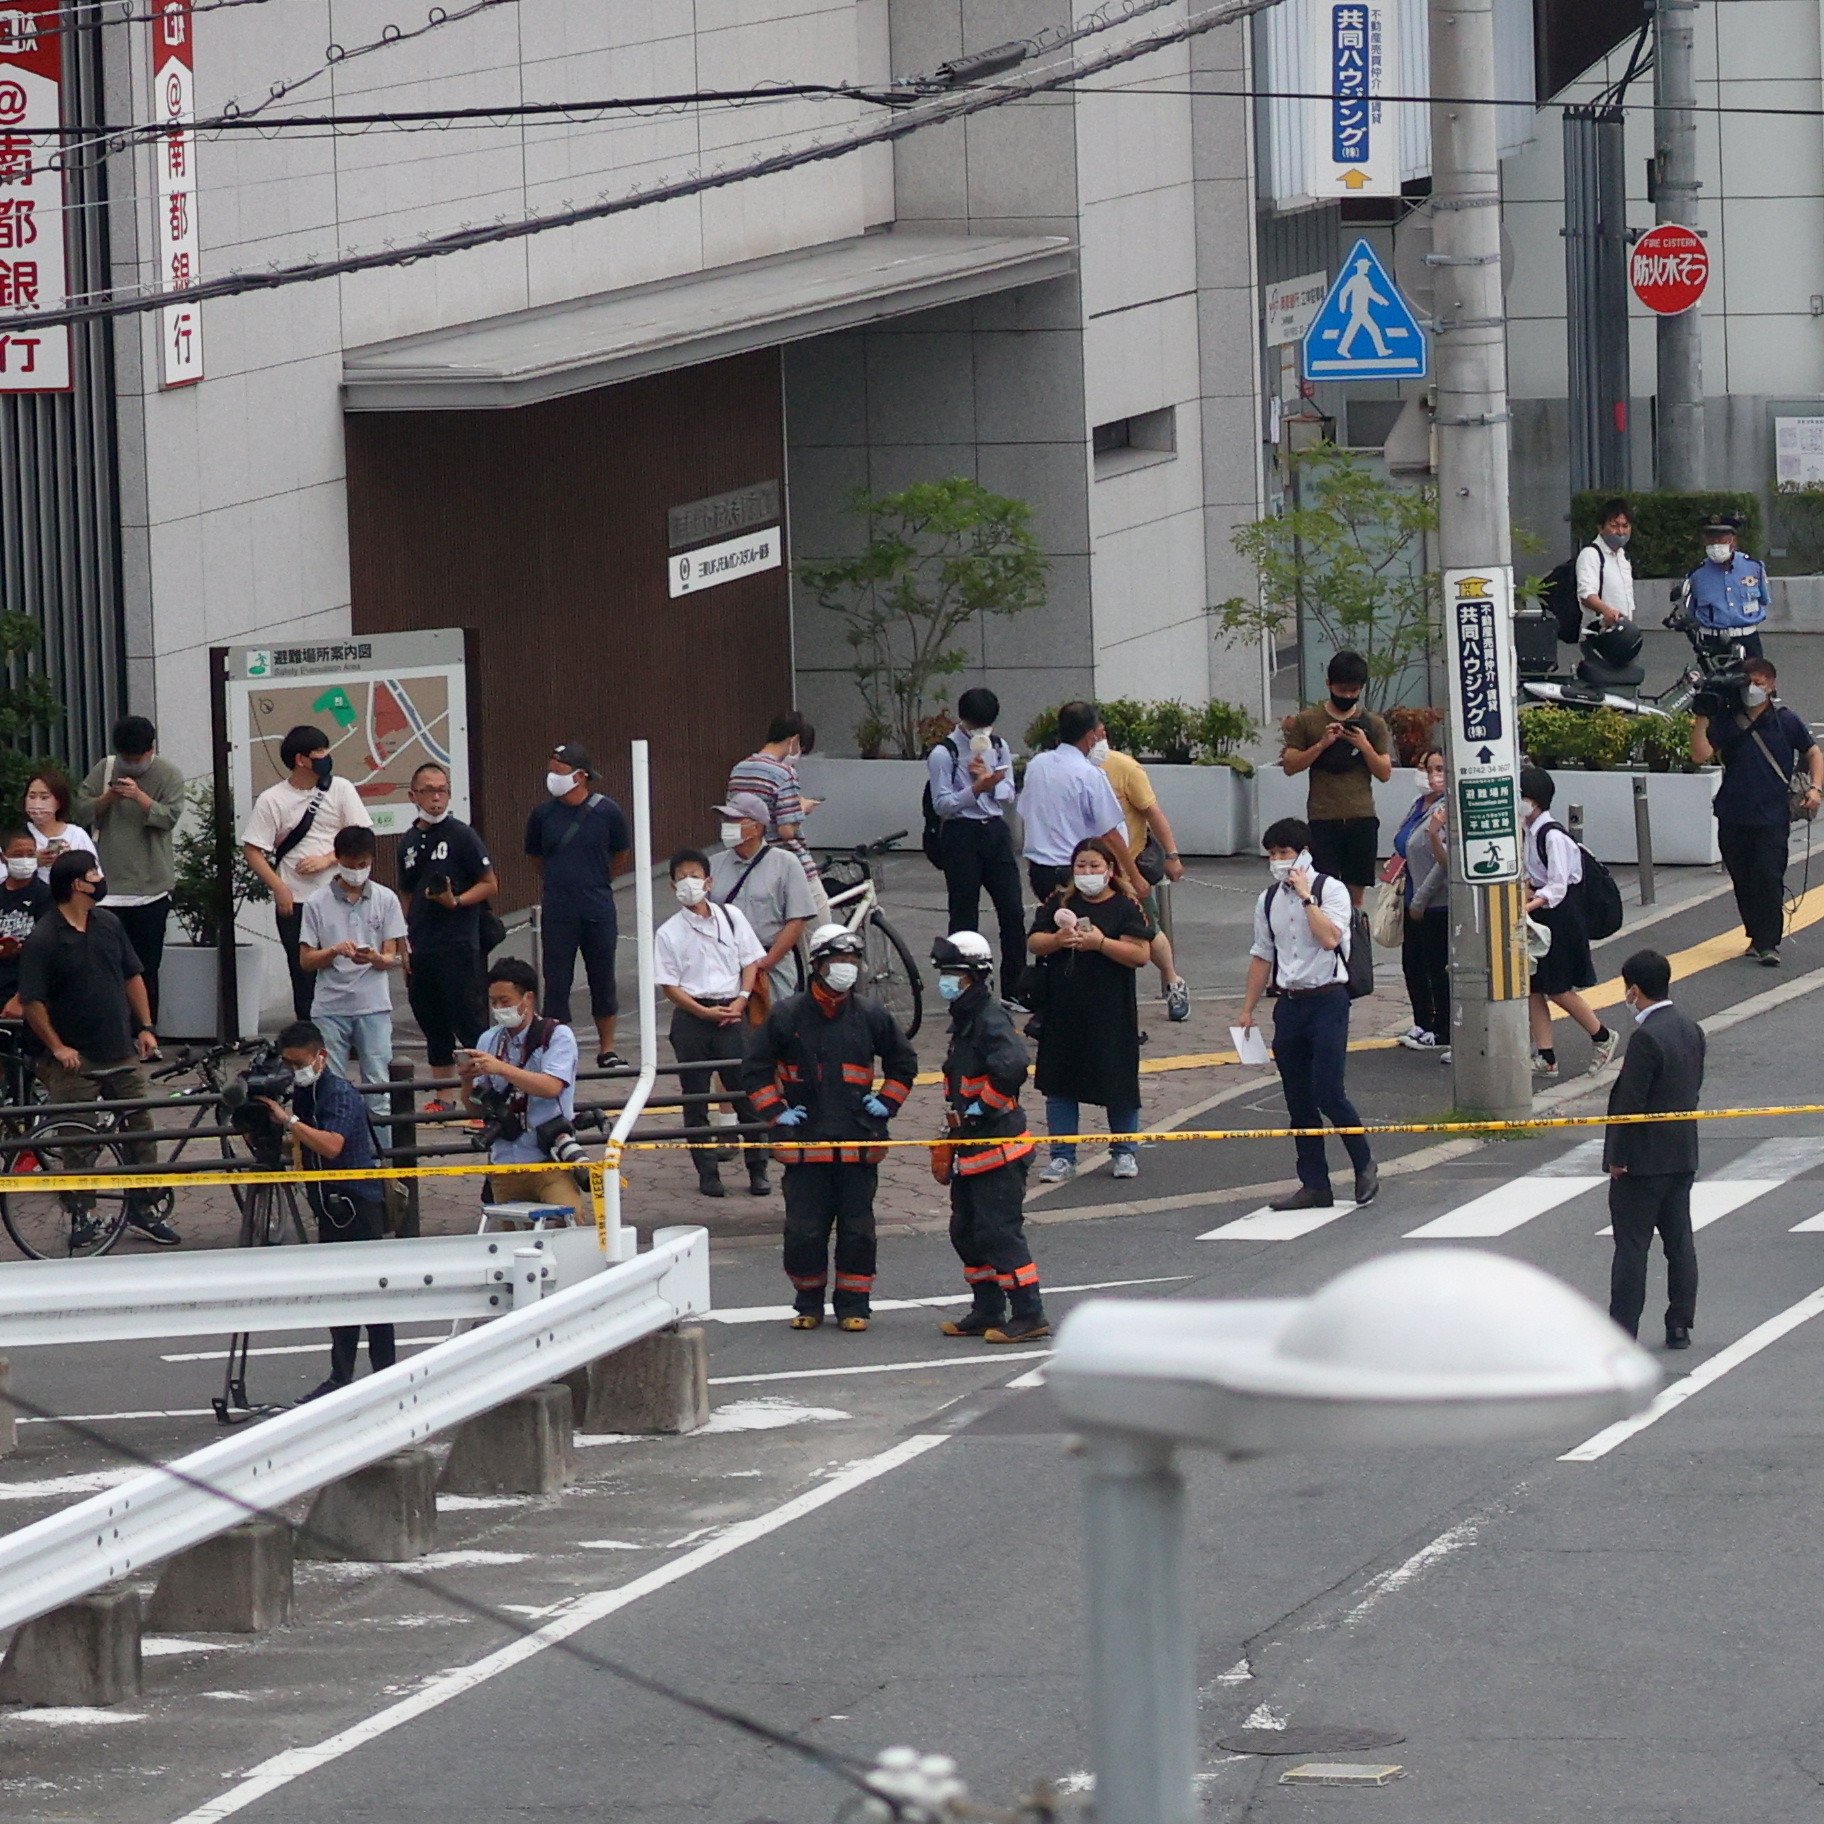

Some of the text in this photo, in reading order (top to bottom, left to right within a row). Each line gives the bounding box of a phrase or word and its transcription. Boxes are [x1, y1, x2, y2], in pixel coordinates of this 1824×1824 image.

[1644, 238, 1697, 248] FIRE CISTERN
[274, 643, 373, 665] 避難場所案内図
[1459, 605, 1486, 738] 共同ハウジング(株)
[1466, 786, 1509, 799] 避難場所
